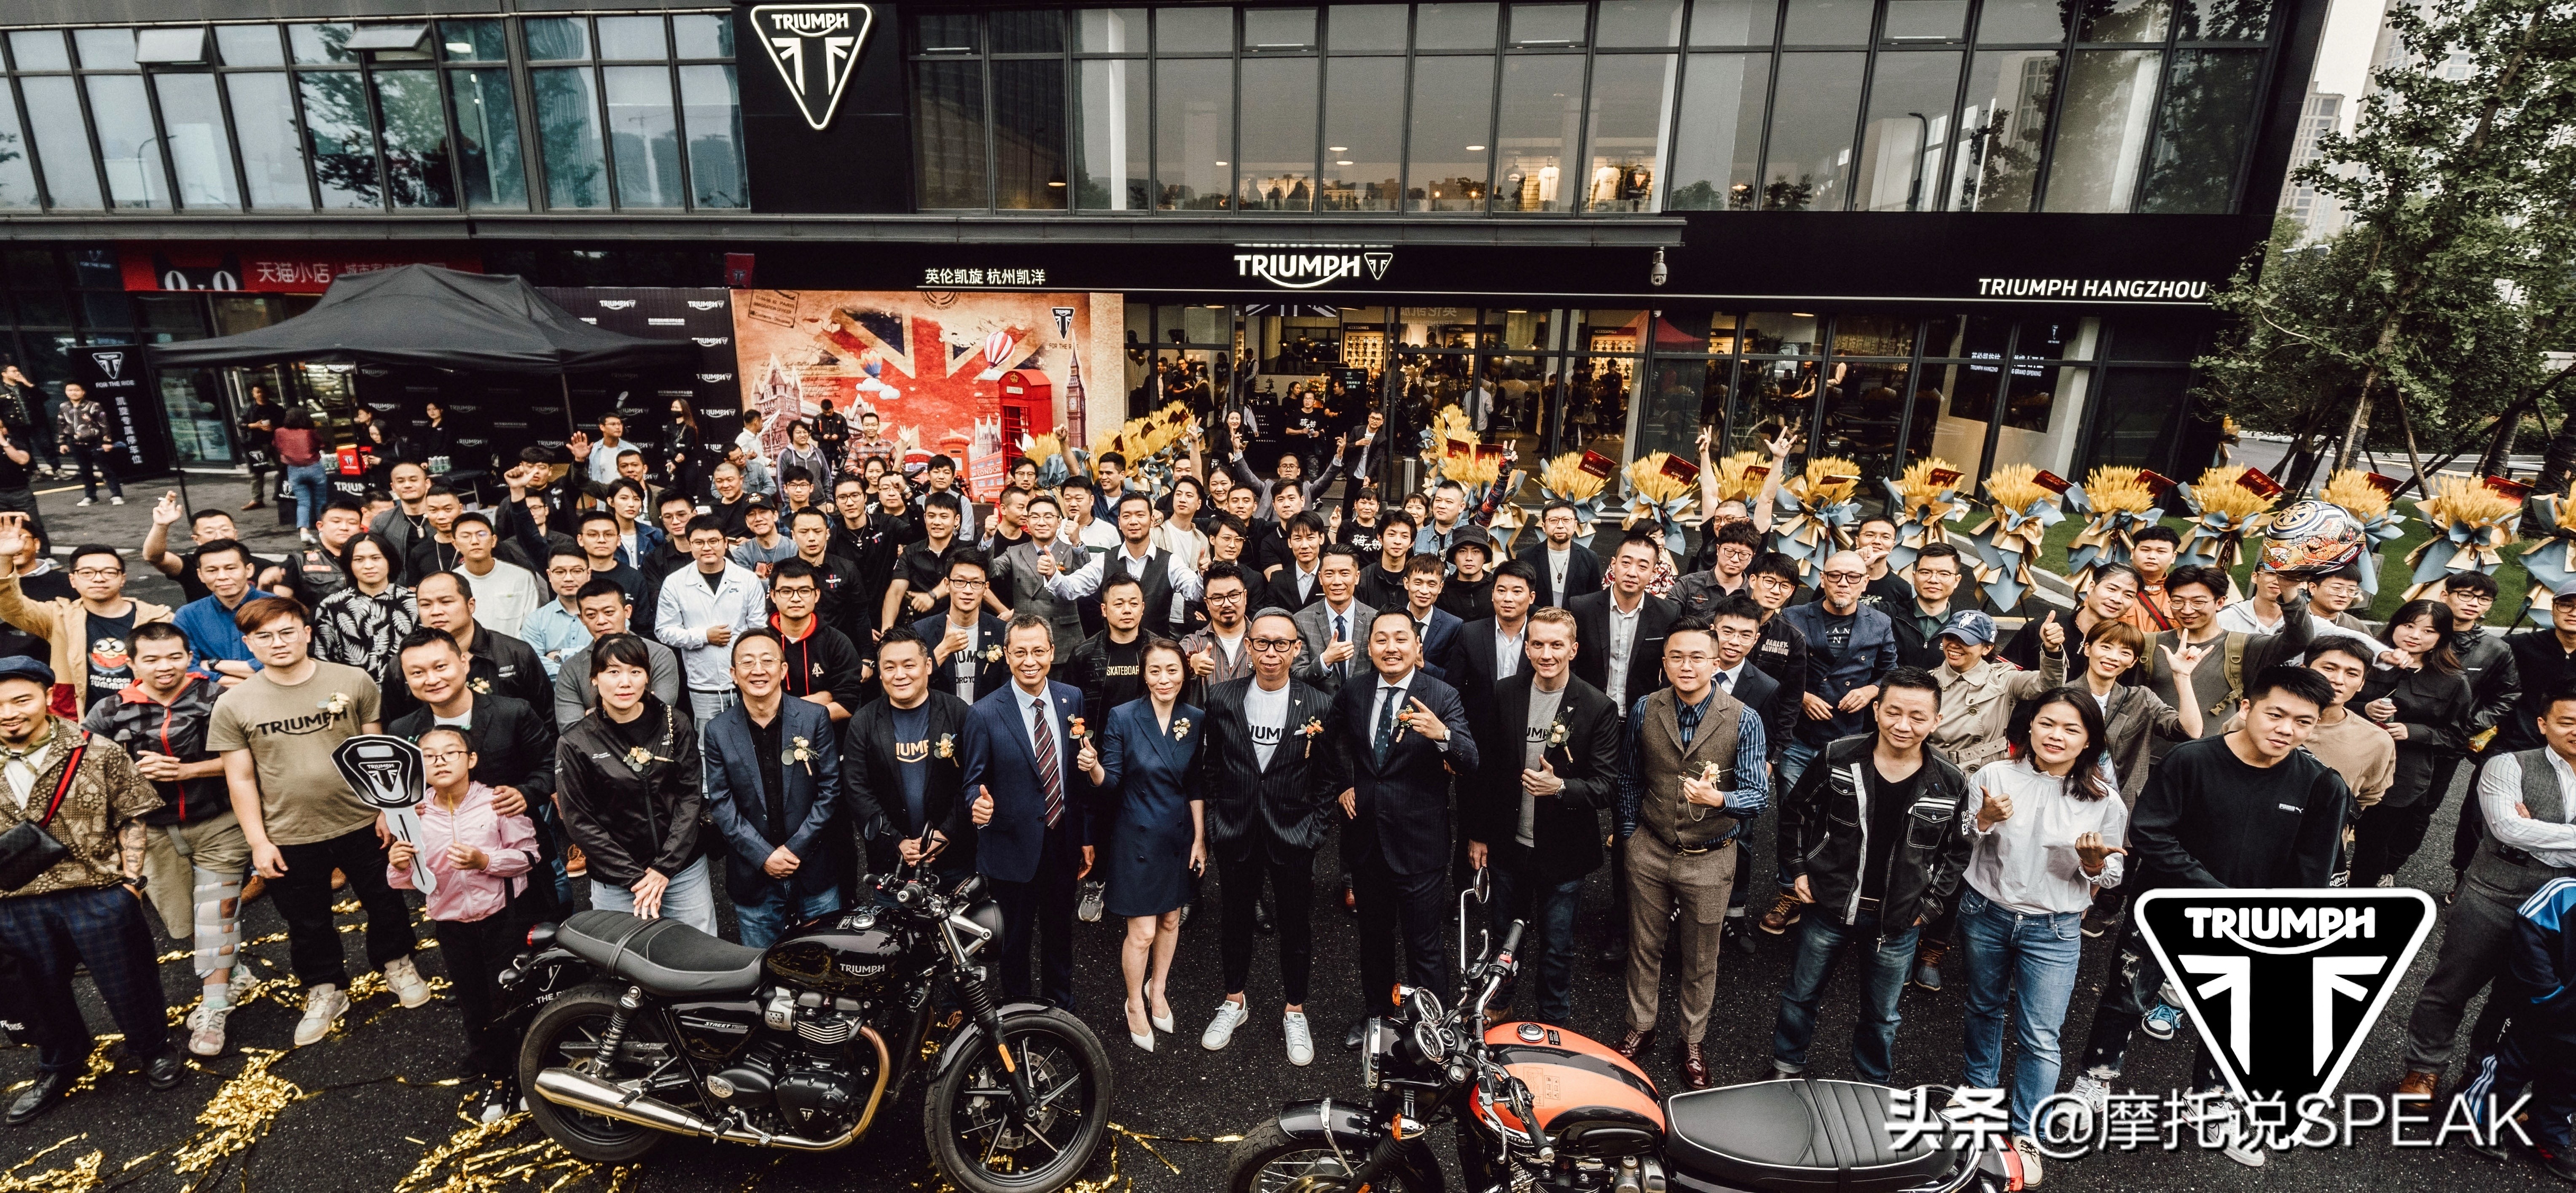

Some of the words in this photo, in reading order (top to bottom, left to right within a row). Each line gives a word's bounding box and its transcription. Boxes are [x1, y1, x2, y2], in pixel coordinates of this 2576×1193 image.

[771, 13, 849, 37] TRIUMPH
[256, 261, 330, 283] 天猫小店
[925, 268, 983, 284] 英伦凯旋
[986, 268, 1045, 285] 杭州凯洋
[1234, 254, 1360, 288] TRIUMPH
[1979, 279, 2078, 296] TRIUMPH
[2082, 279, 2207, 299] HANGZHOU
[599, 300, 630, 310] TRIUMPH
[688, 300, 718, 311] TRIUMPH
[977, 466, 1002, 477] LONDON
[2342, 548, 2356, 560] SHOEI
[840, 963, 885, 977] TRIUMPH
[536, 993, 554, 1004] THE
